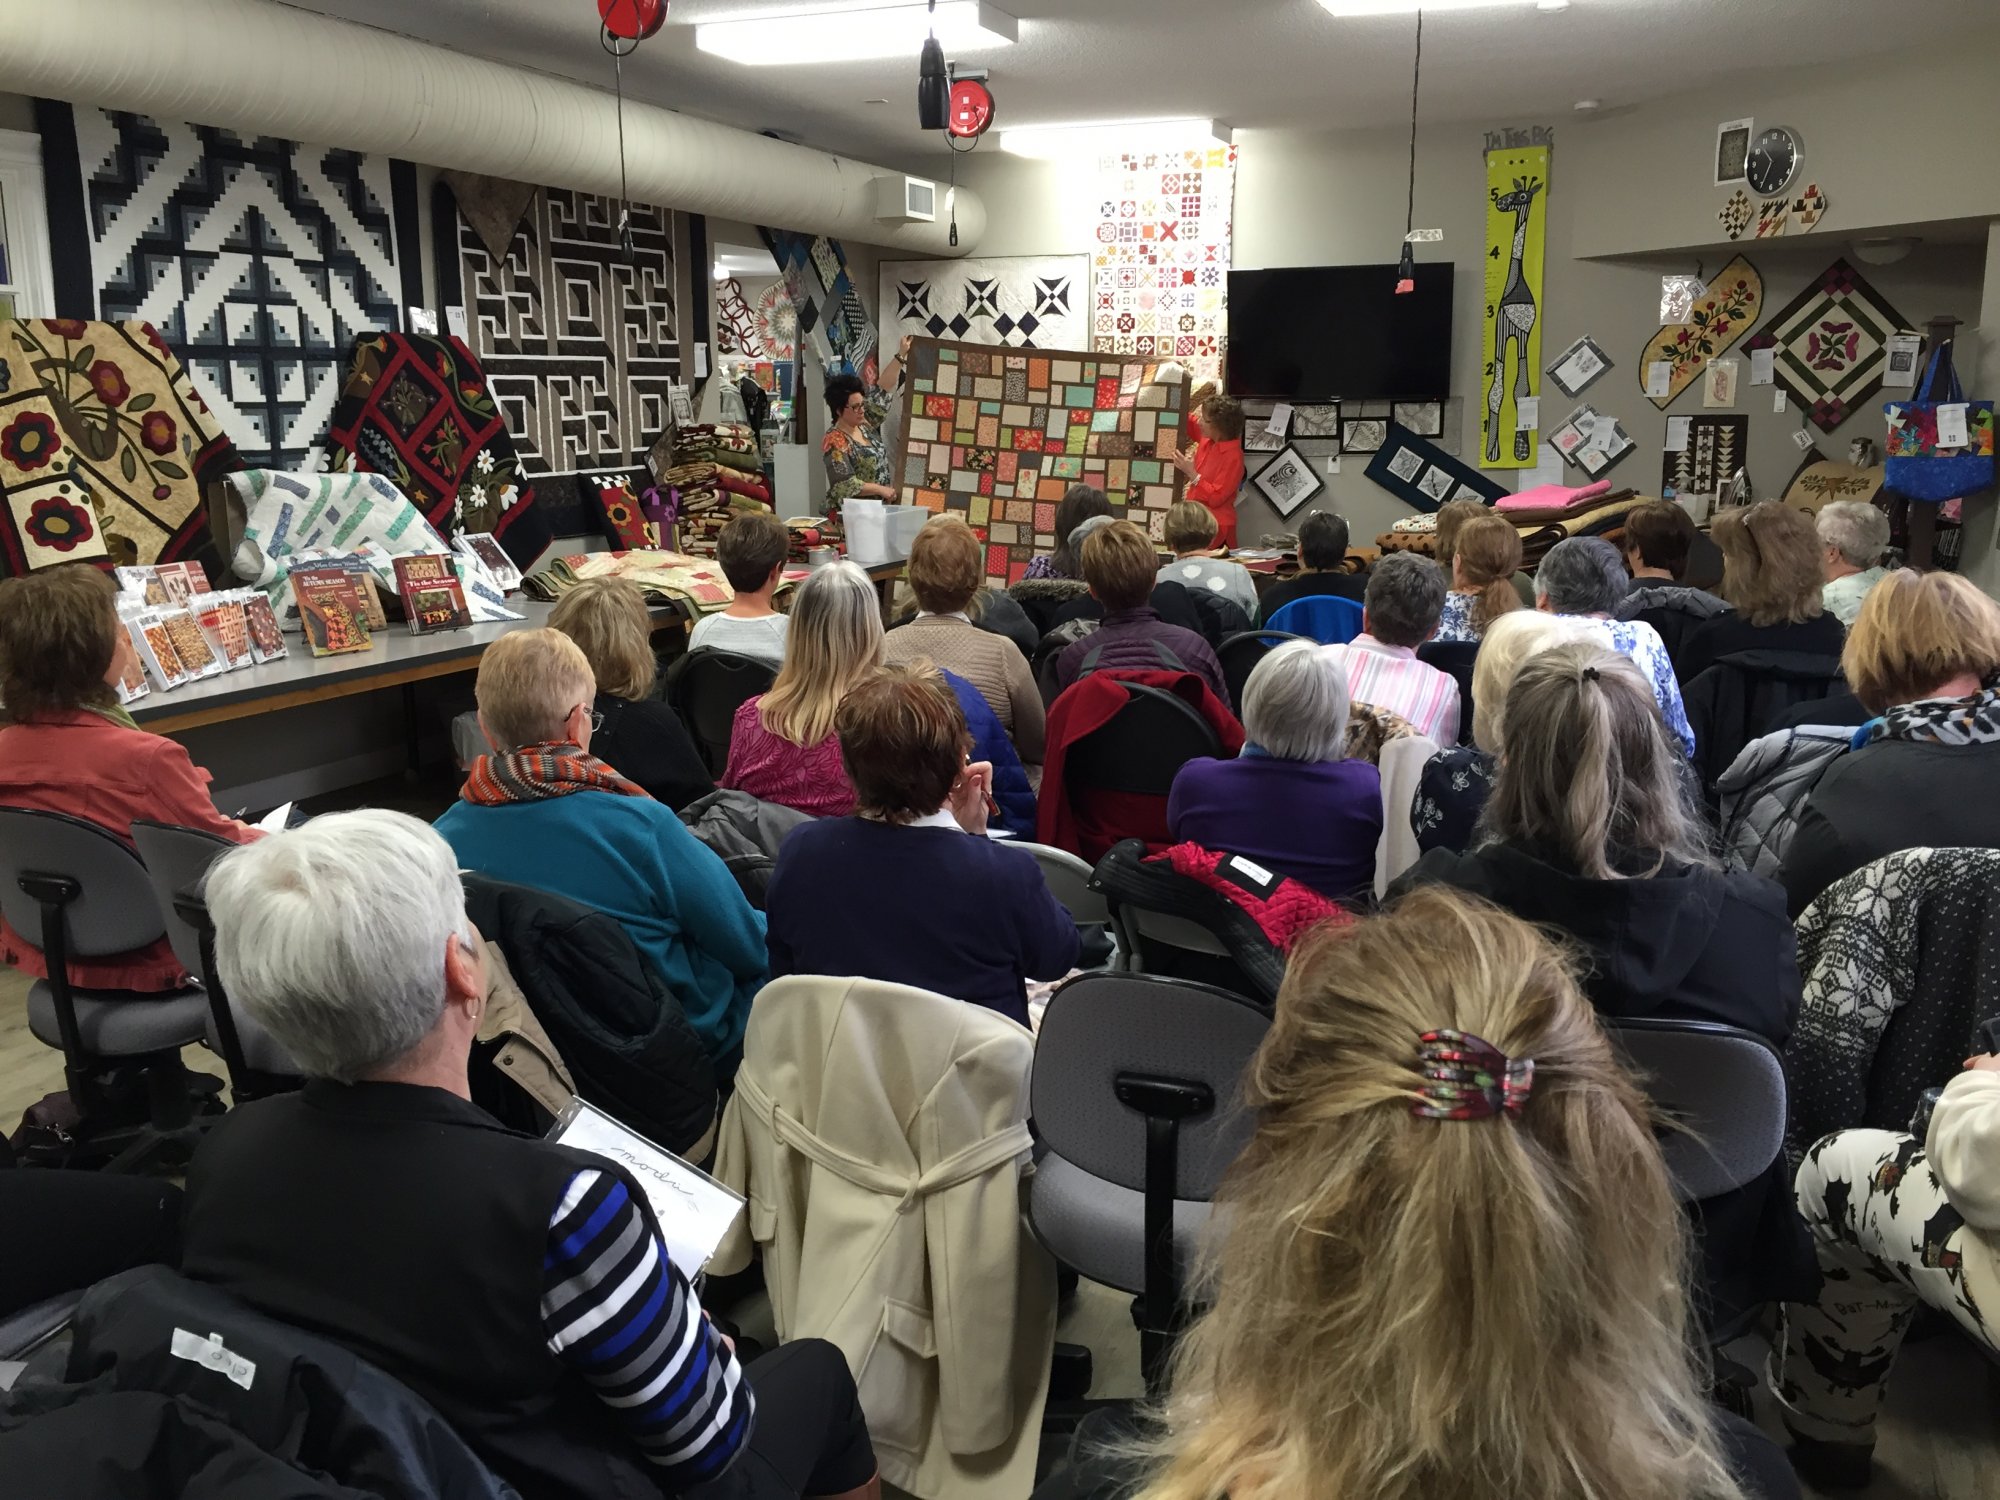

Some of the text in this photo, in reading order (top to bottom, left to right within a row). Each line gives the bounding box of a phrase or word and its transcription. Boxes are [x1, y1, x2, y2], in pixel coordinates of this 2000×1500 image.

[1490, 187, 1499, 202] 5
[1489, 245, 1500, 260] 4
[1487, 304, 1494, 318] 3
[1485, 362, 1494, 376] 2
[1483, 419, 1489, 433] 1
[325, 577, 346, 585] SEASON
